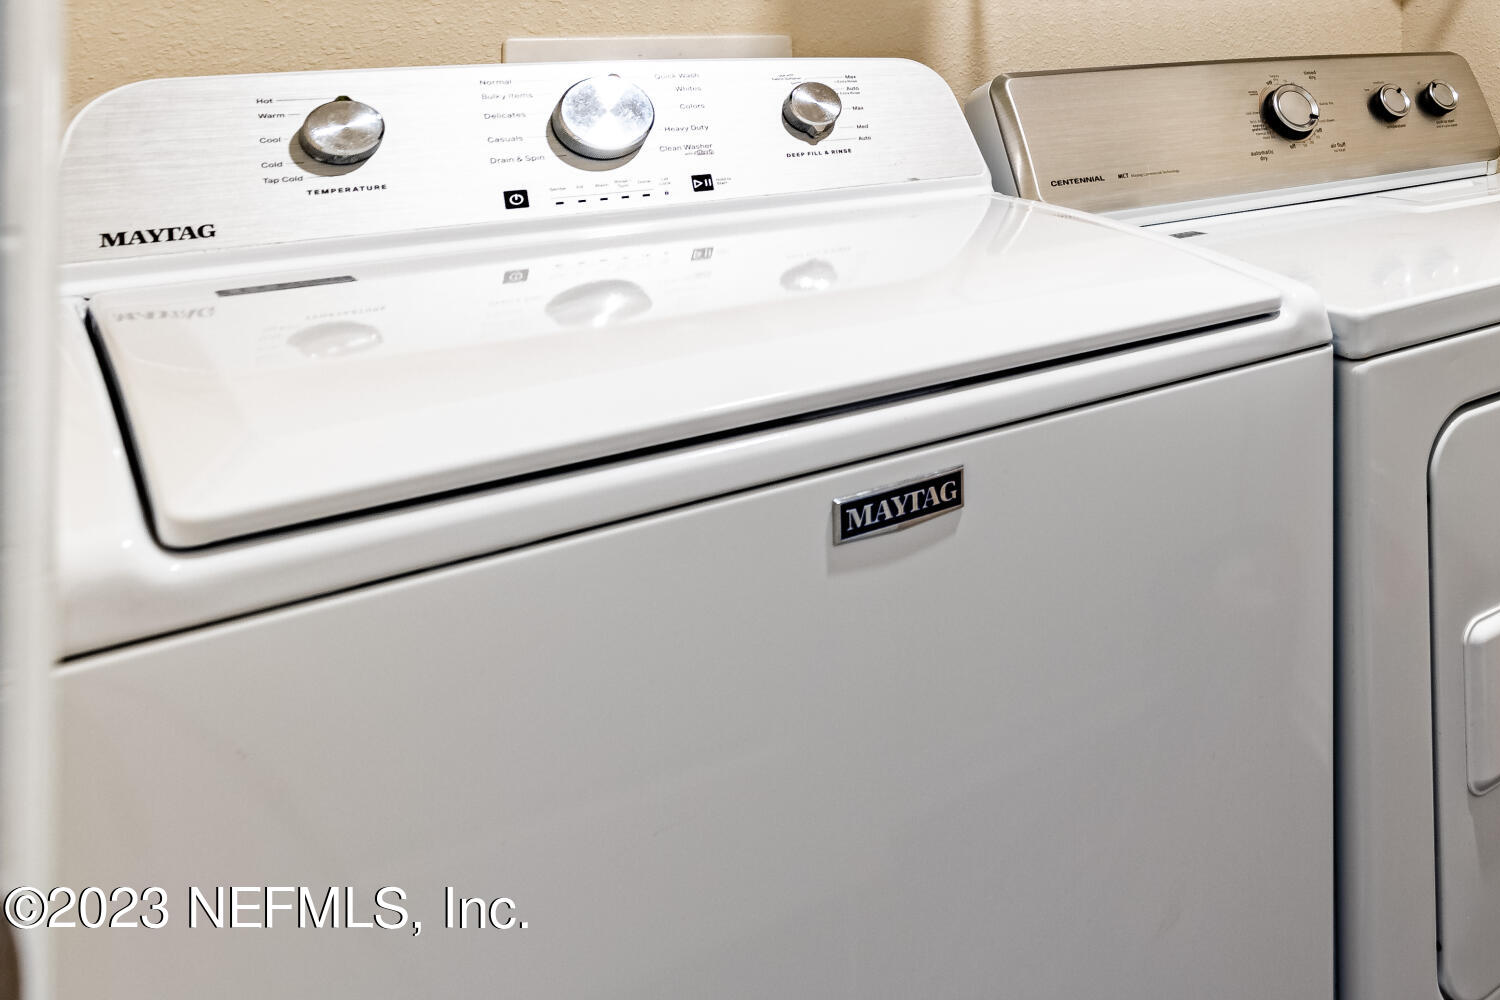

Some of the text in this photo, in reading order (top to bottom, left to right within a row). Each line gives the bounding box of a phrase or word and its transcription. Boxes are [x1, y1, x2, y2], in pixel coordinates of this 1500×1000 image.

[483, 112, 527, 120] Delicates
[487, 135, 524, 143] Casuals
[260, 161, 283, 169] Cold
[490, 156, 514, 165] Drain
[525, 154, 546, 163] Spin
[263, 175, 304, 185] Tap Cold
[1050, 174, 1106, 187] CENTENNIAL
[306, 183, 388, 196] TEMPERATURE
[98, 223, 217, 248] MAYTAG
[845, 480, 958, 532] MAYTAG
